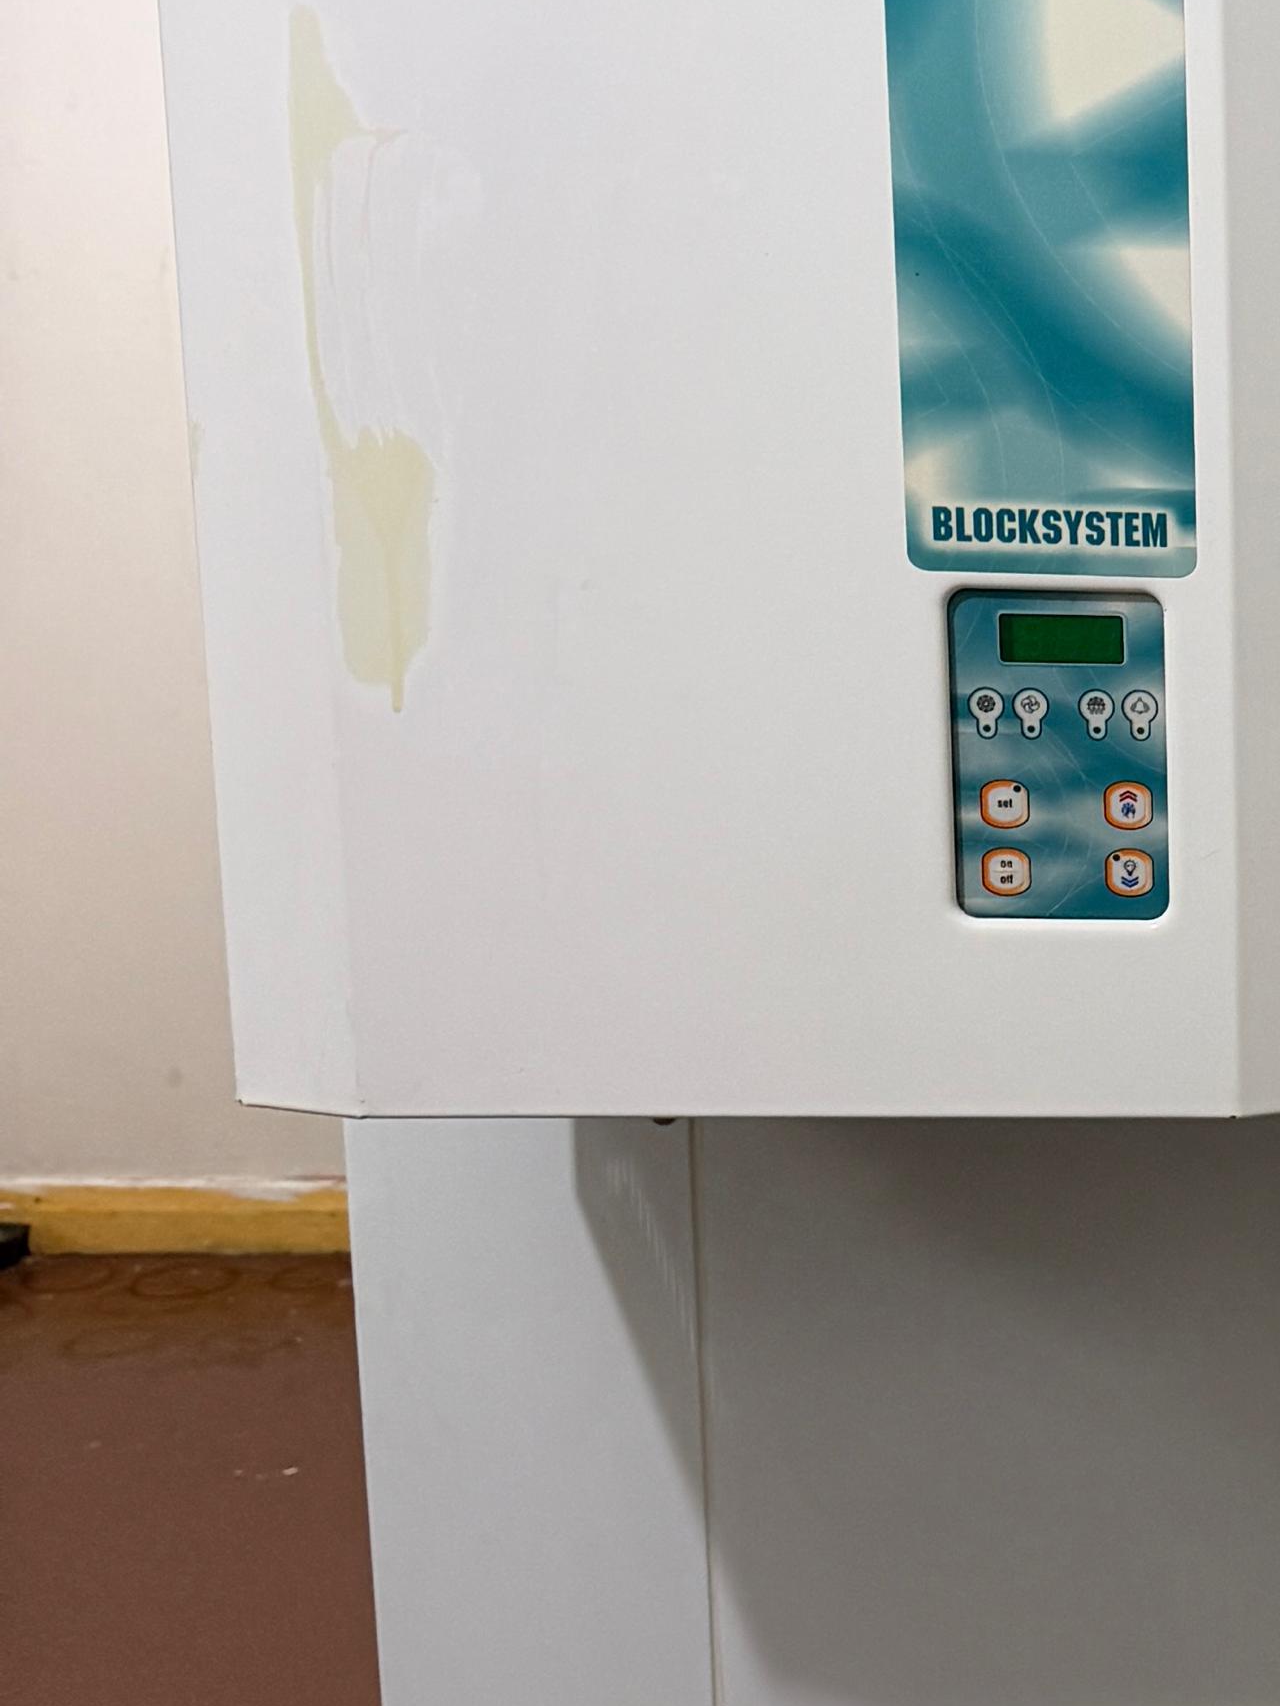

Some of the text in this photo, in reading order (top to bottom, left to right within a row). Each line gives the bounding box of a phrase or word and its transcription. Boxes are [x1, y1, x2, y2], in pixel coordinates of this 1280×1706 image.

[932, 505, 1168, 548] BLOCKSYSTEM
[997, 797, 1013, 809] set
[1000, 859, 1013, 870] on
[1000, 873, 1014, 885] off
